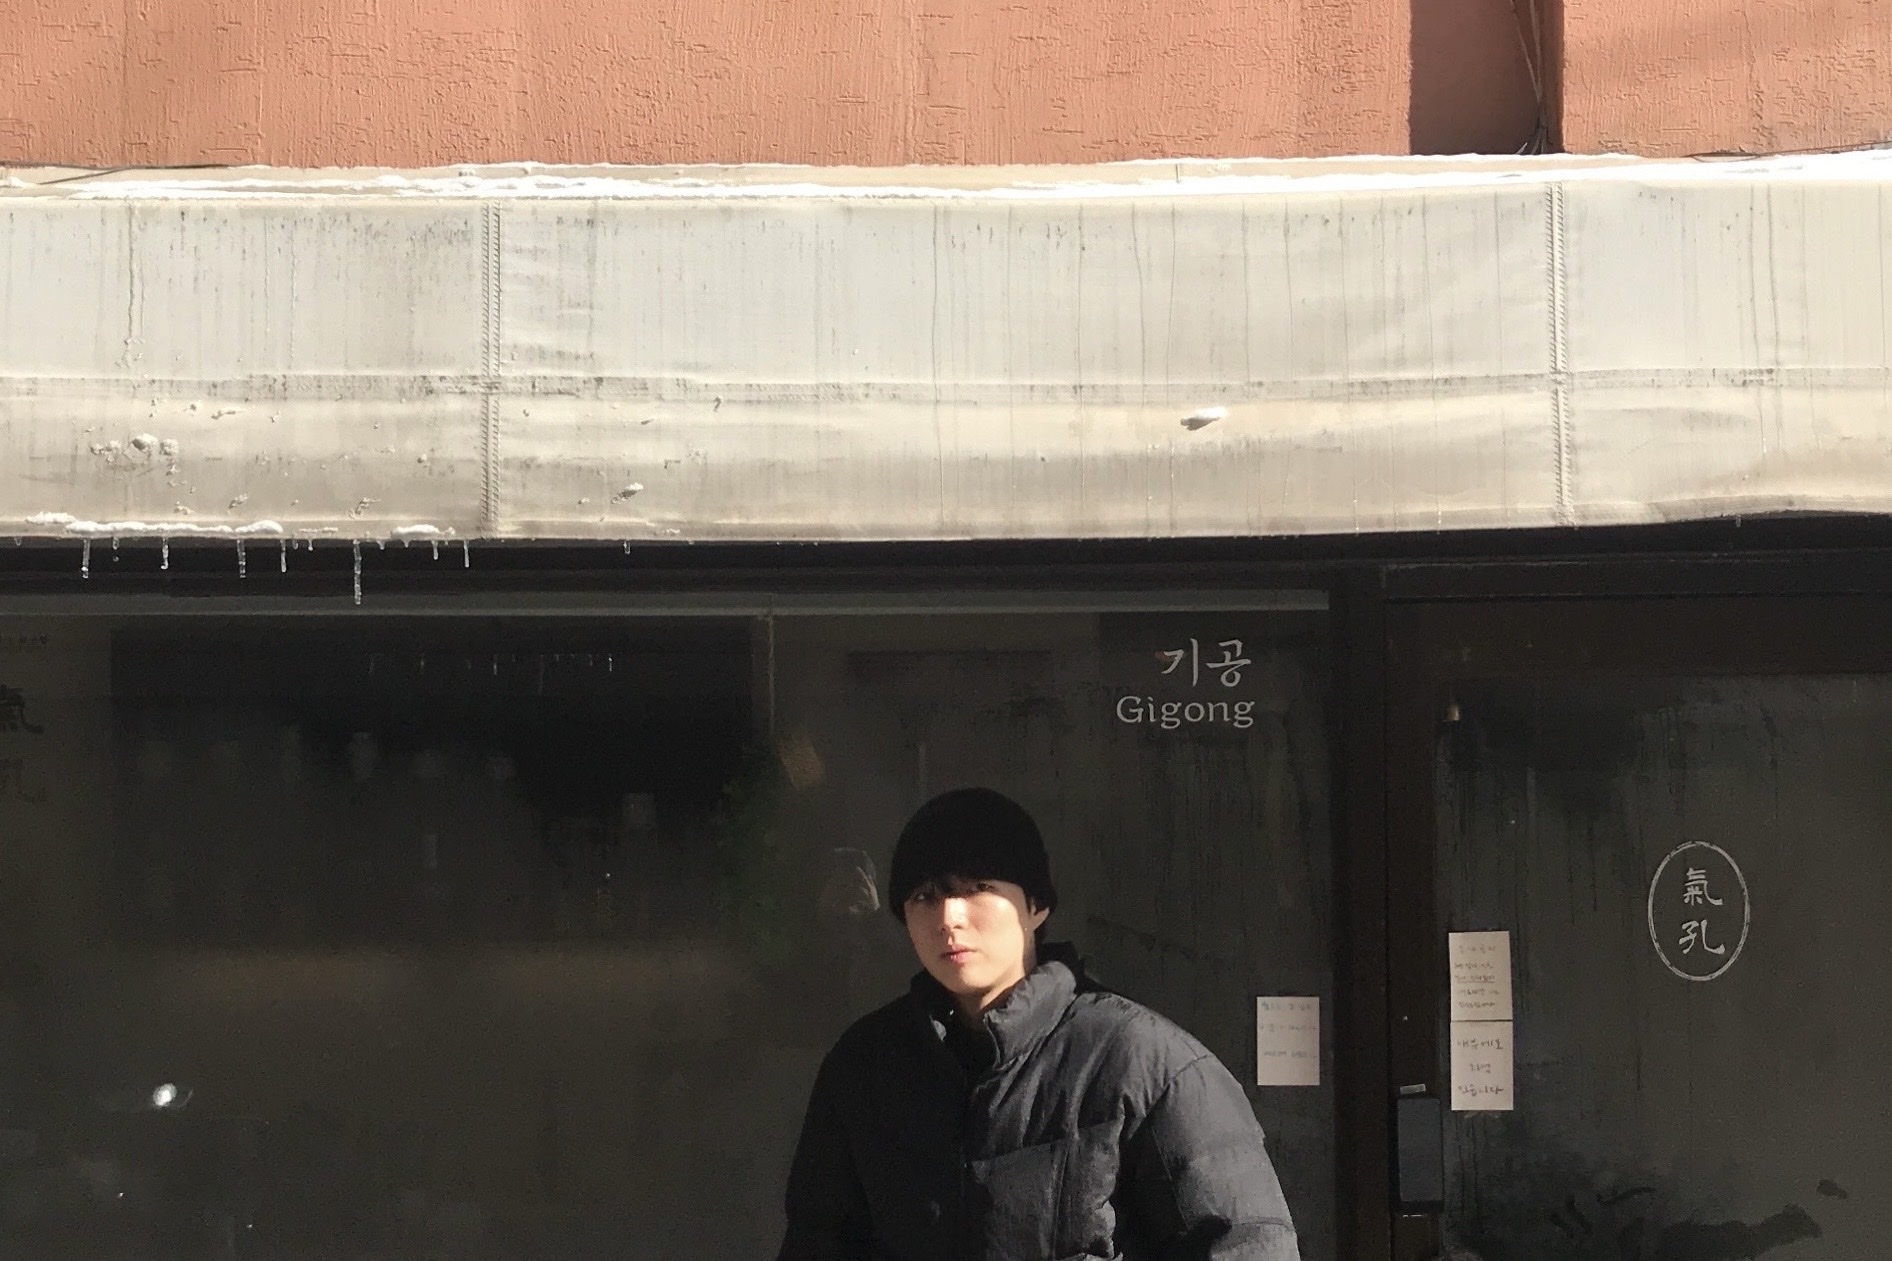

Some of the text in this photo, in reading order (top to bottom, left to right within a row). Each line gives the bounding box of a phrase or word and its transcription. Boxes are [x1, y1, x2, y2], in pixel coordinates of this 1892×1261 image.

[1161, 637, 1252, 688] 기공
[1116, 695, 1256, 730] Gigong
[1678, 866, 1726, 955] 氣孔
